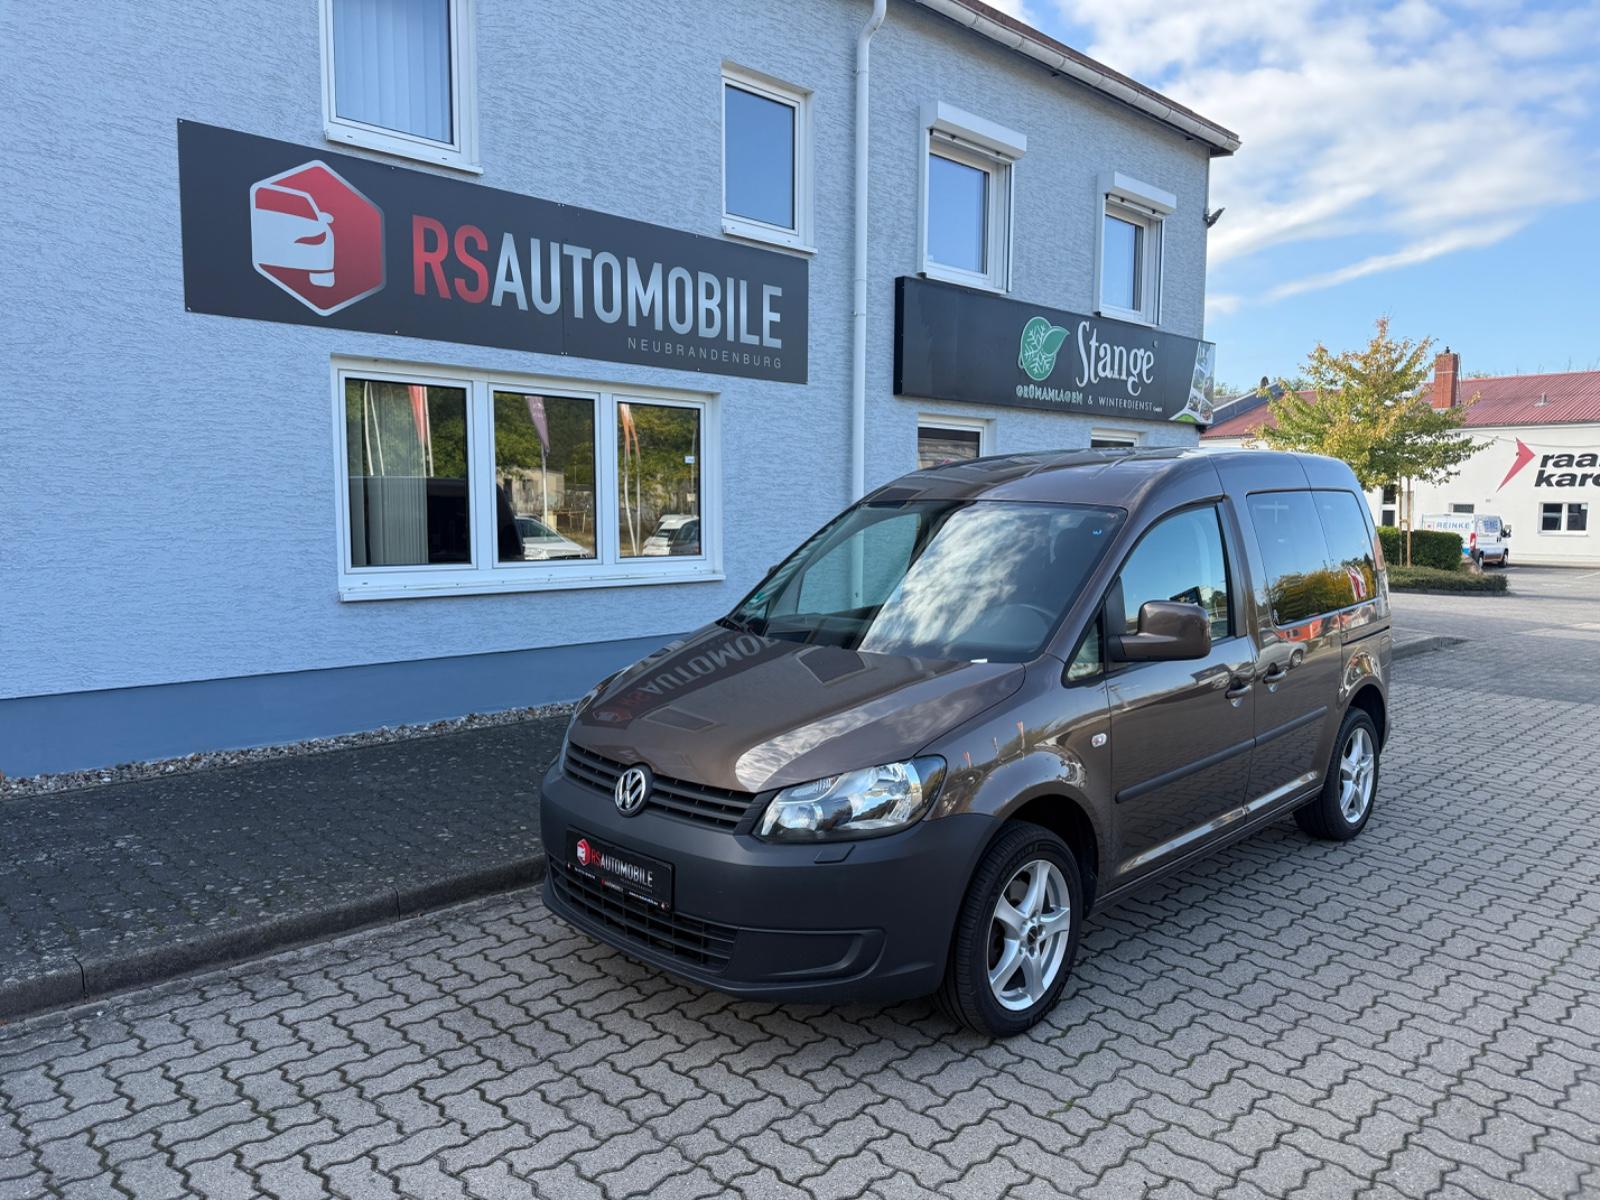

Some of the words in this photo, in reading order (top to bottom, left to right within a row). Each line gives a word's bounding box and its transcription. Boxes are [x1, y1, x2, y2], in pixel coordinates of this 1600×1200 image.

[412, 214, 782, 349] RSAUTOMOBILE
[627, 336, 782, 369] NEUBRANDENBURG
[1075, 320, 1154, 396] Stange
[1087, 394, 1093, 405] &
[1098, 396, 1152, 411] WINTERDIENST
[1540, 453, 1600, 468] raa
